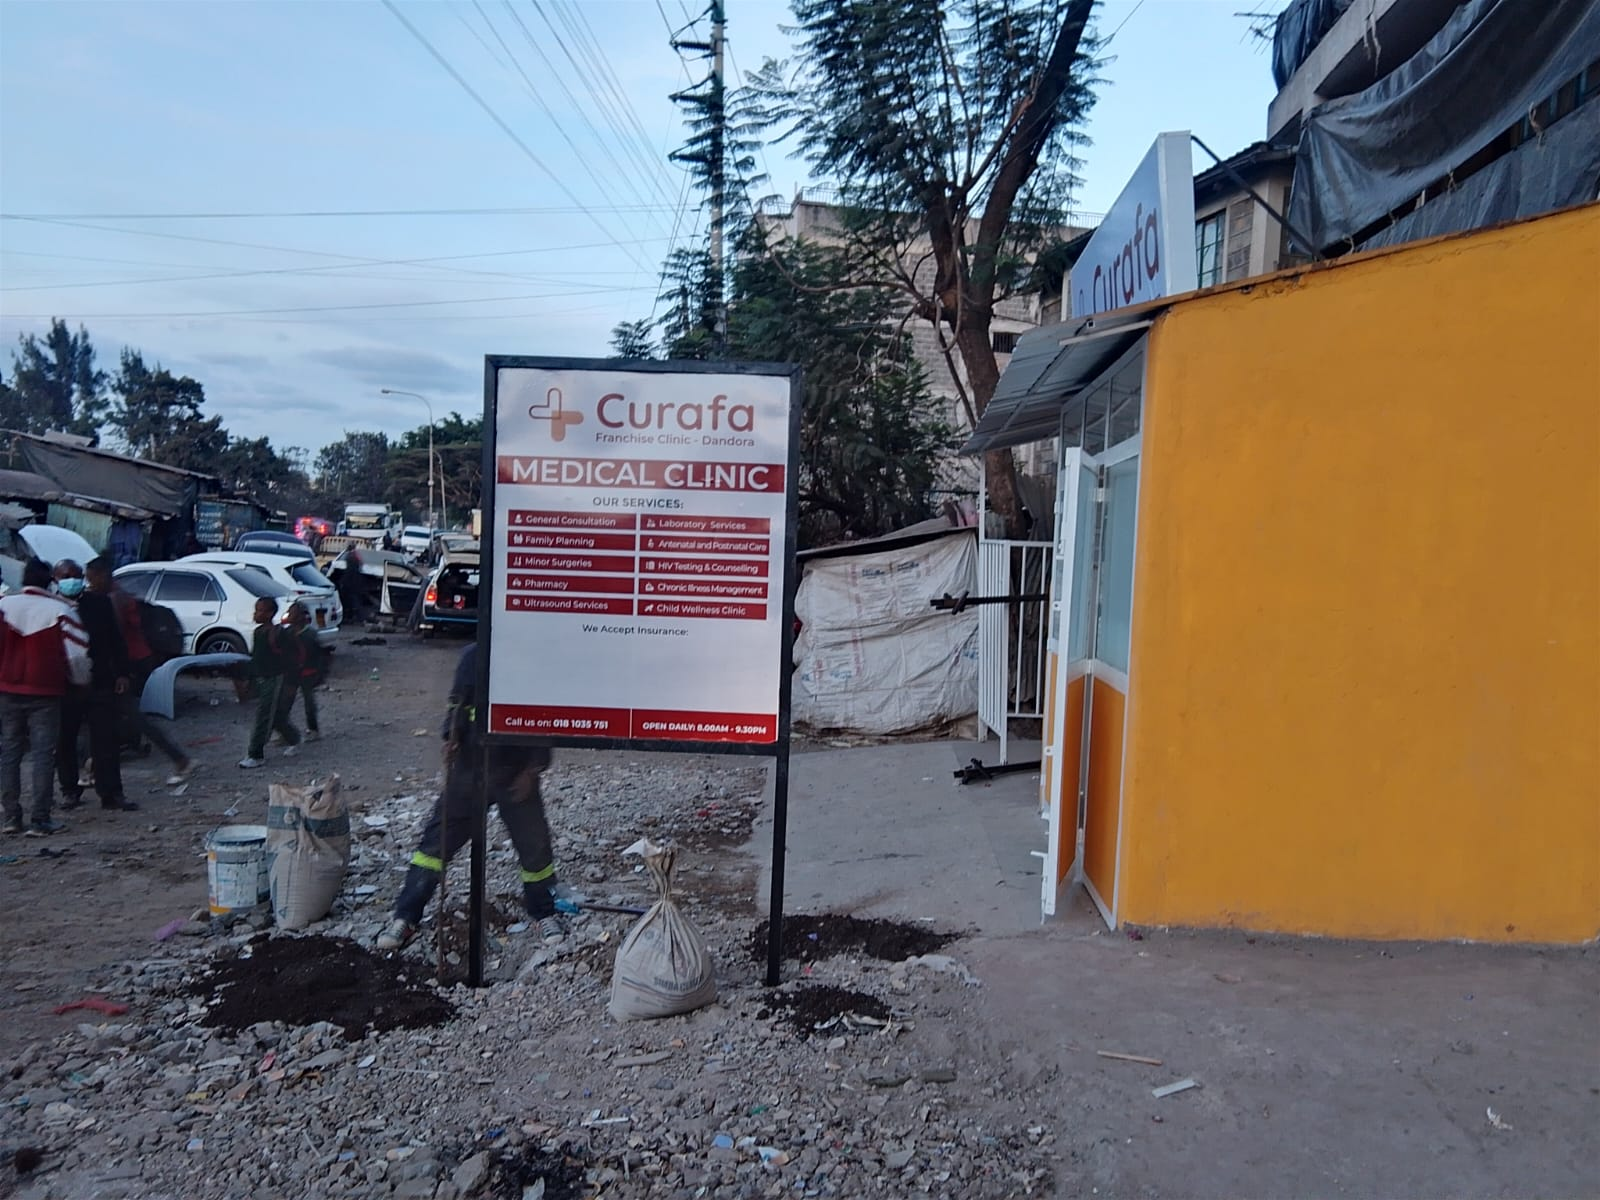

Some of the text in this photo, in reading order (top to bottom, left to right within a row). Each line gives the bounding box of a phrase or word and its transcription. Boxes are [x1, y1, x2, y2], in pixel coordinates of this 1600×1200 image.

[597, 393, 754, 432] Curafa
[595, 432, 654, 445] Franchise
[658, 434, 692, 446] Clinic
[702, 435, 755, 447] Dandora
[511, 459, 769, 491] MEDICAL CLINIC
[592, 496, 684, 509] OUR SERVICES:
[525, 514, 616, 527] General Consultation
[659, 519, 746, 531] Laboratory Services
[525, 535, 595, 548] Family Planning
[525, 558, 593, 569] Minor Surgeries
[658, 562, 759, 575] HIV Testing & Counselling
[524, 578, 569, 590] Pharmacy
[657, 583, 687, 592] Chronic
[524, 598, 609, 610] Ultrasound Services
[656, 604, 746, 616] Child Wellness Clinic
[582, 624, 689, 636] We Accept Insurance:
[505, 717, 522, 727] Call
[524, 719, 535, 727] us
[537, 719, 551, 728] on:
[642, 721, 667, 731] OPEN
[668, 722, 696, 732] DAILY:
